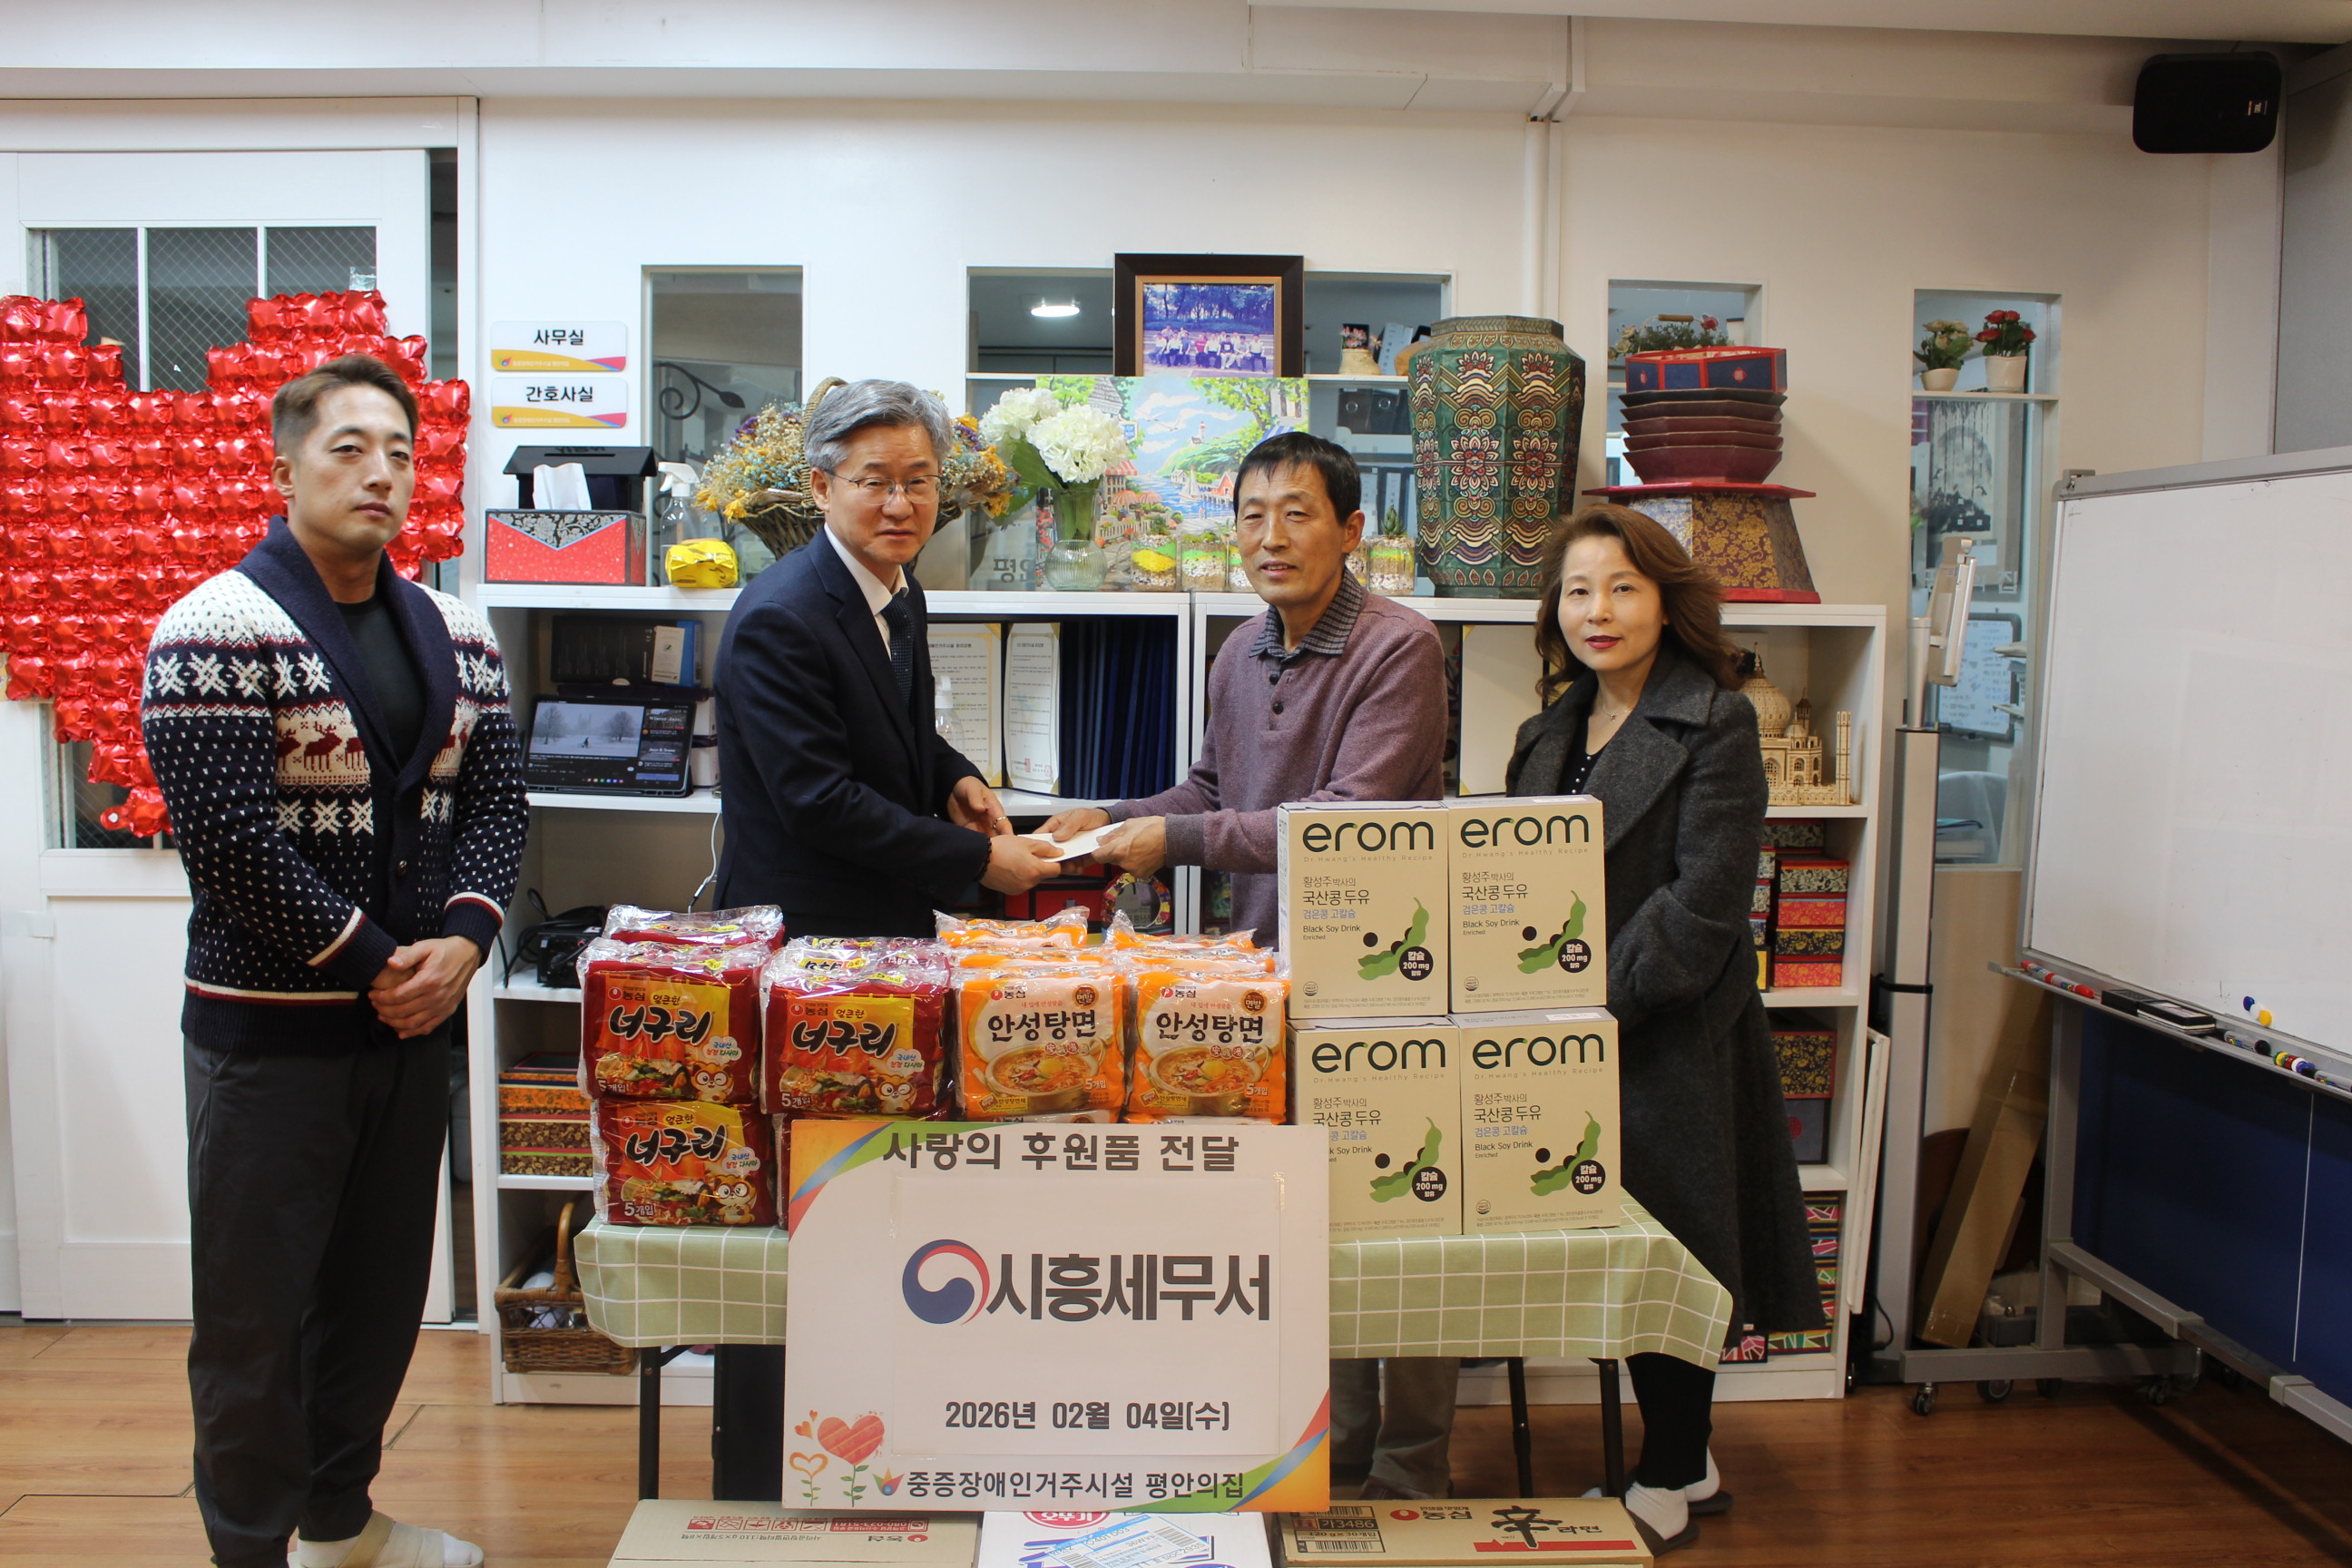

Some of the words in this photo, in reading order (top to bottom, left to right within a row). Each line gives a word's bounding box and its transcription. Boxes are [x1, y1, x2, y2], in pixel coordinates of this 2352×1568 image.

[534, 329, 583, 346] 사무실
[526, 386, 593, 402] 간호사실
[1303, 822, 1433, 852] erom
[1461, 815, 1589, 848] erom
[1303, 891, 1341, 906] 국산콩
[1344, 890, 1370, 905] 두유
[1462, 885, 1499, 901] 국산콩
[1503, 884, 1528, 899] 두유
[1303, 909, 1328, 920] 검은콩
[1332, 909, 1356, 919] 고칼슘
[1463, 905, 1487, 915] 검은콩
[1490, 904, 1514, 913] 고칼슘
[1326, 926, 1339, 934] Soy
[1566, 944, 1583, 953] 칼슘
[1408, 951, 1425, 961] 칼슘
[623, 992, 645, 1001] 농심
[652, 994, 680, 1005] 얼큰한
[1004, 990, 1025, 999] 농심
[1077, 994, 1093, 1004] 면발
[1246, 998, 1261, 1009] 면발
[836, 1009, 864, 1019] 얼큰한
[609, 1005, 712, 1045] 너구리
[988, 1009, 1096, 1042] 안성탕면
[1156, 1012, 1263, 1044] 안성탕면
[792, 1020, 896, 1058] 너구리
[1312, 1039, 1446, 1073] erom
[1473, 1034, 1604, 1069] erom
[598, 1079, 626, 1093] 5개입
[1085, 1079, 1107, 1089] 5개입
[1246, 1083, 1267, 1096] 5개입
[781, 1093, 811, 1107] 5개입
[666, 1114, 694, 1125] 얼큰한
[1313, 1112, 1352, 1127] 국산콩
[1356, 1110, 1381, 1125] 두유
[1474, 1107, 1513, 1123] 국산콩
[1516, 1105, 1542, 1121] 두유
[635, 1117, 657, 1126] 농심
[1342, 1131, 1367, 1140] 고칼슘
[1475, 1127, 1499, 1137] 검은콩
[1503, 1126, 1527, 1135] 고칼슘
[626, 1124, 726, 1166] 너구리
[882, 1132, 1001, 1170] 사랑의
[1021, 1133, 1140, 1171] 후원품
[1159, 1136, 1239, 1171] 전달
[1421, 1172, 1438, 1181] 칼슘
[1581, 1165, 1597, 1174] 칼슘
[624, 1202, 654, 1216] 5개입
[985, 1253, 1270, 1322] 시흥세무서
[945, 1401, 1036, 1430] 2026년
[1052, 1402, 1110, 1430] 02월
[906, 1472, 1133, 1499] 중증장애인거주시설
[1145, 1471, 1244, 1499] 평안의집
[1423, 1511, 1472, 1520] 농심
[1322, 1519, 1375, 1529] 가3486
[1491, 1505, 1563, 1548] 辛
[1557, 1526, 1602, 1534] 라면
